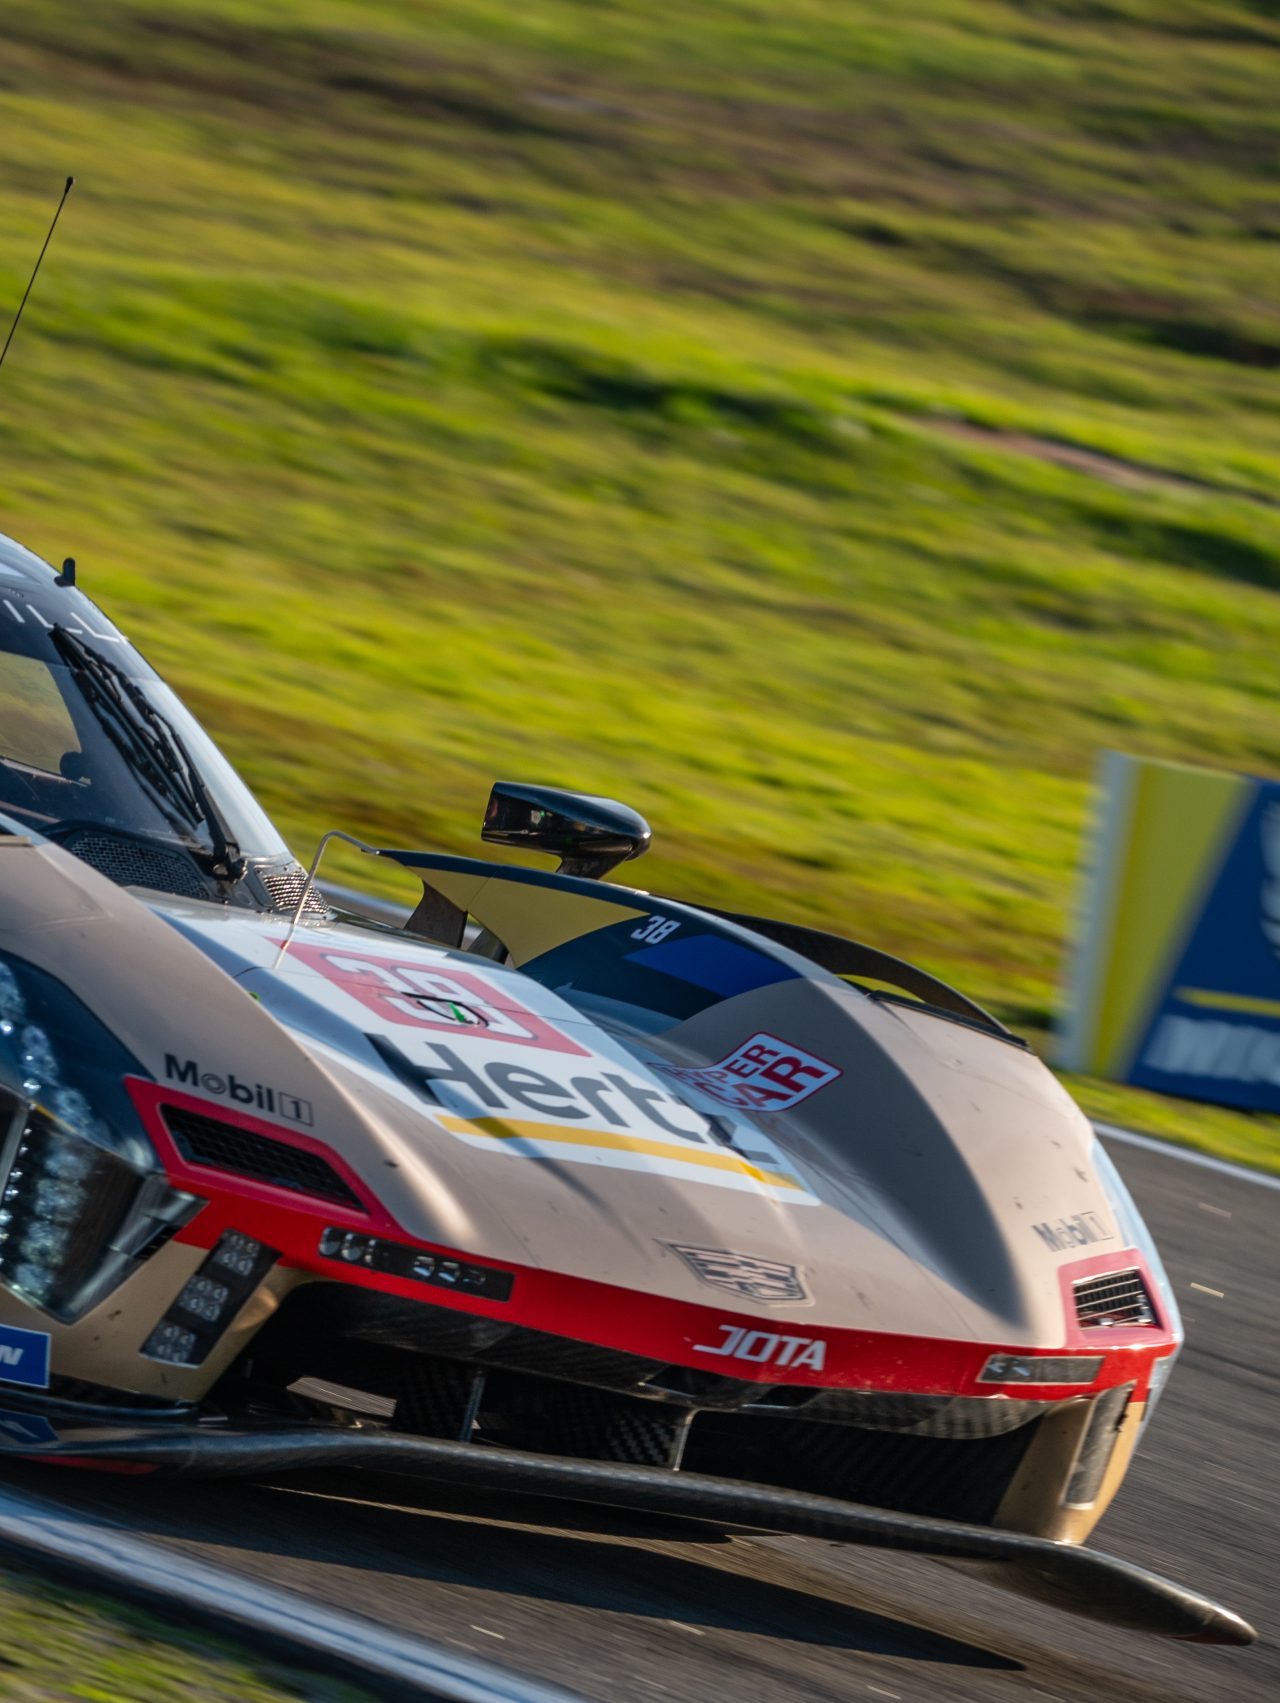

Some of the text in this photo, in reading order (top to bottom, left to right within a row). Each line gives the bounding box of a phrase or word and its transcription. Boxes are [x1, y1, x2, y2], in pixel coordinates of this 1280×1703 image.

[630, 915, 682, 944] 38
[164, 1053, 275, 1113] Mobil
[693, 1055, 829, 1108] CAR
[692, 1324, 827, 1371] JOTA
